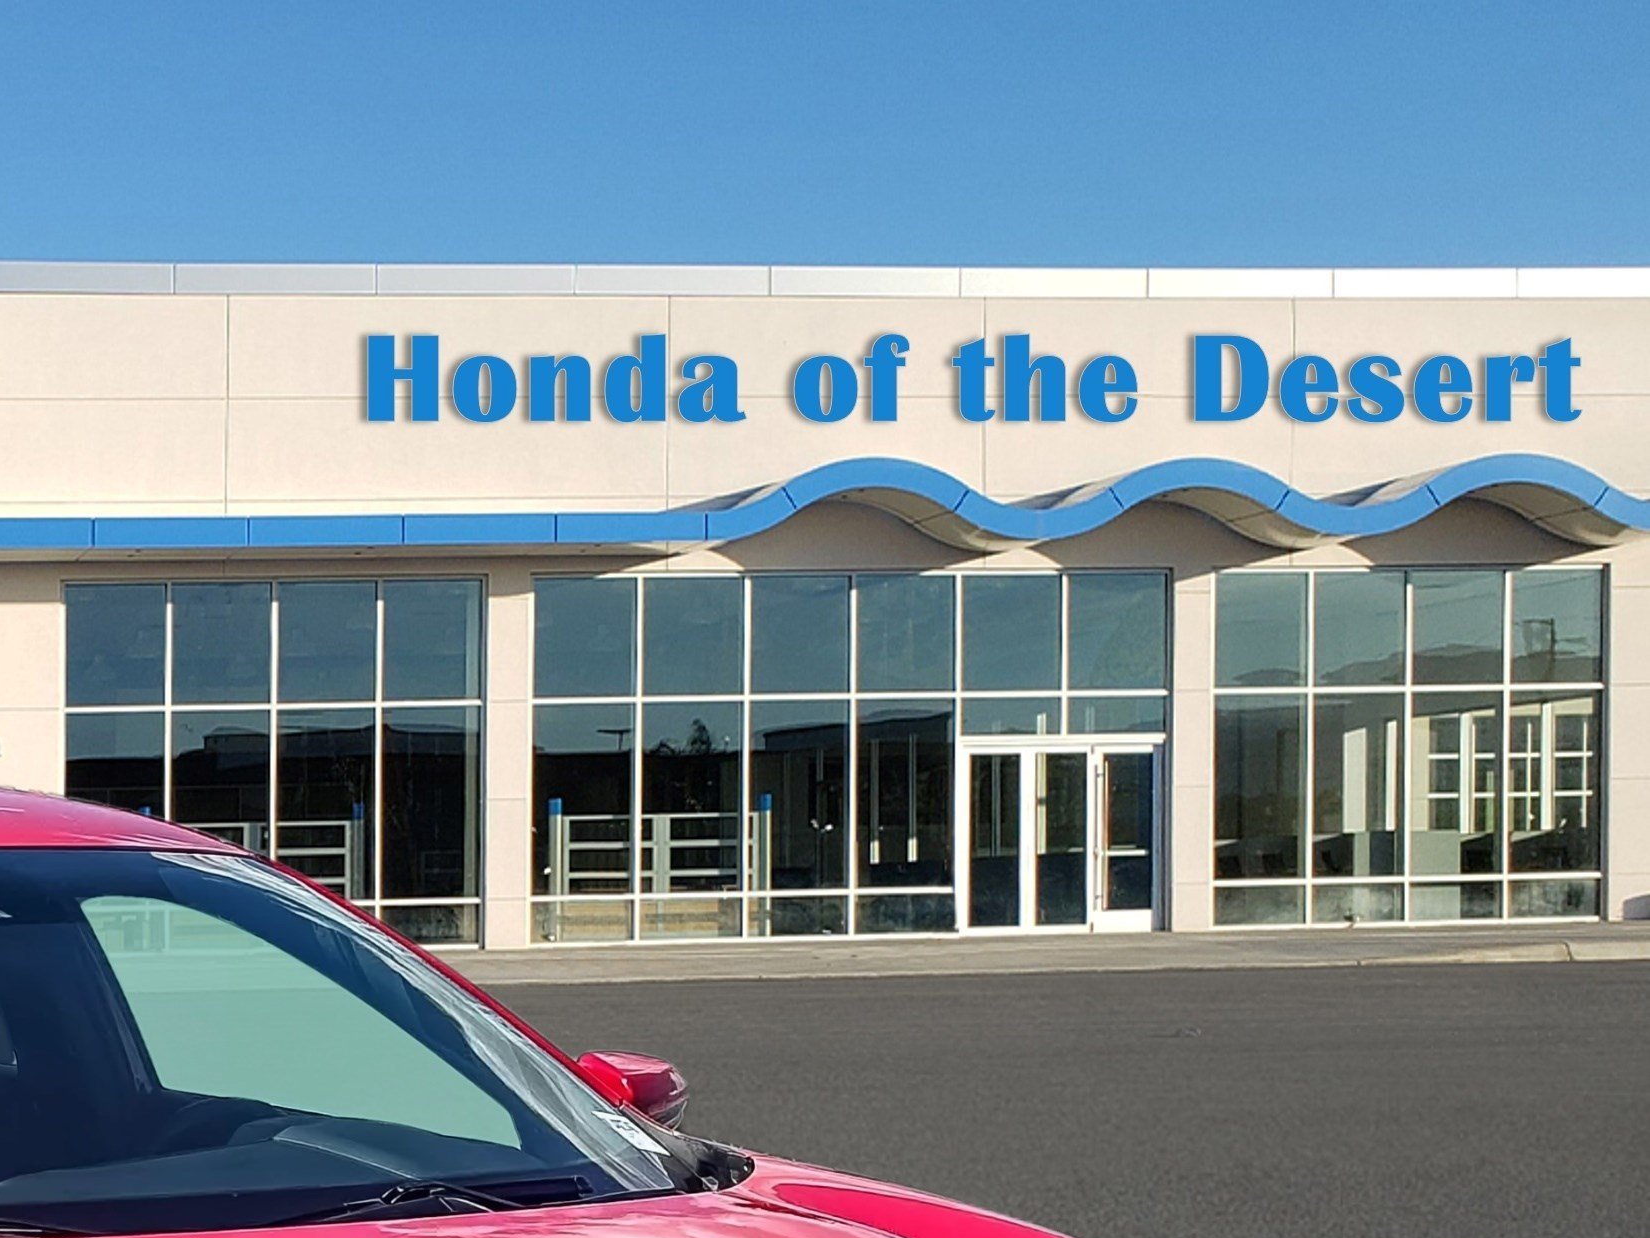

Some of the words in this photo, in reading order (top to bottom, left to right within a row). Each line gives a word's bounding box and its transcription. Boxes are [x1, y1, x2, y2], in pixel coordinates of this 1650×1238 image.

[366, 333, 747, 424] Honda
[793, 332, 911, 424] of
[951, 333, 1139, 424] the
[1193, 334, 1582, 424] Desert
